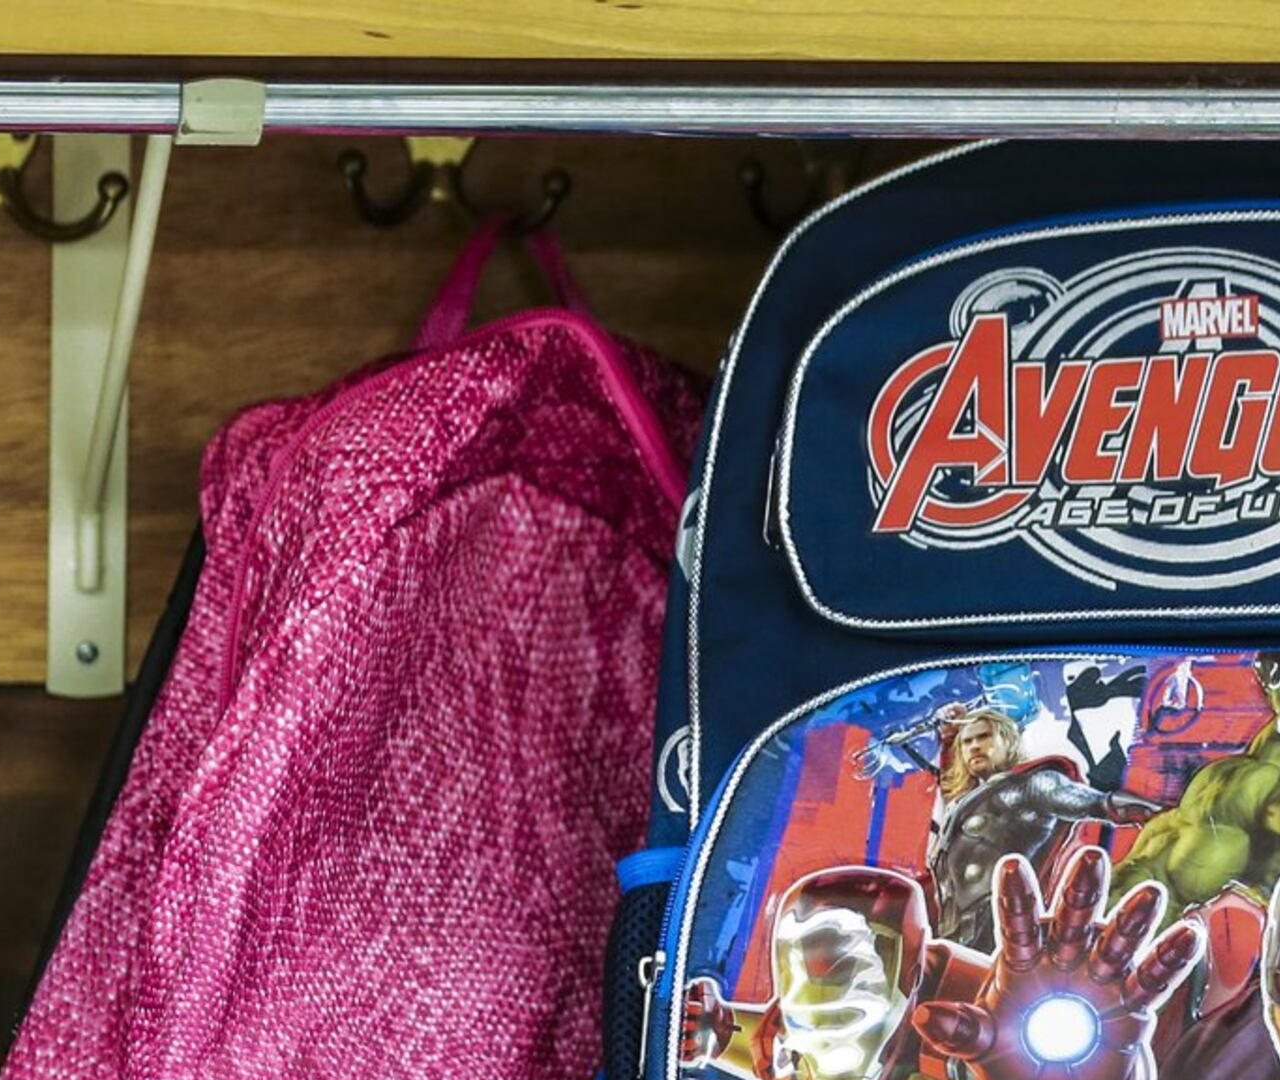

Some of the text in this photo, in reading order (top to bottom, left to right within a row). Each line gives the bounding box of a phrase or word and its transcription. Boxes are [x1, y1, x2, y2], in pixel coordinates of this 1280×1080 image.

[1162, 297, 1257, 338] MARVEL
[1018, 497, 1131, 528] AGE
[1147, 491, 1223, 523] OF
